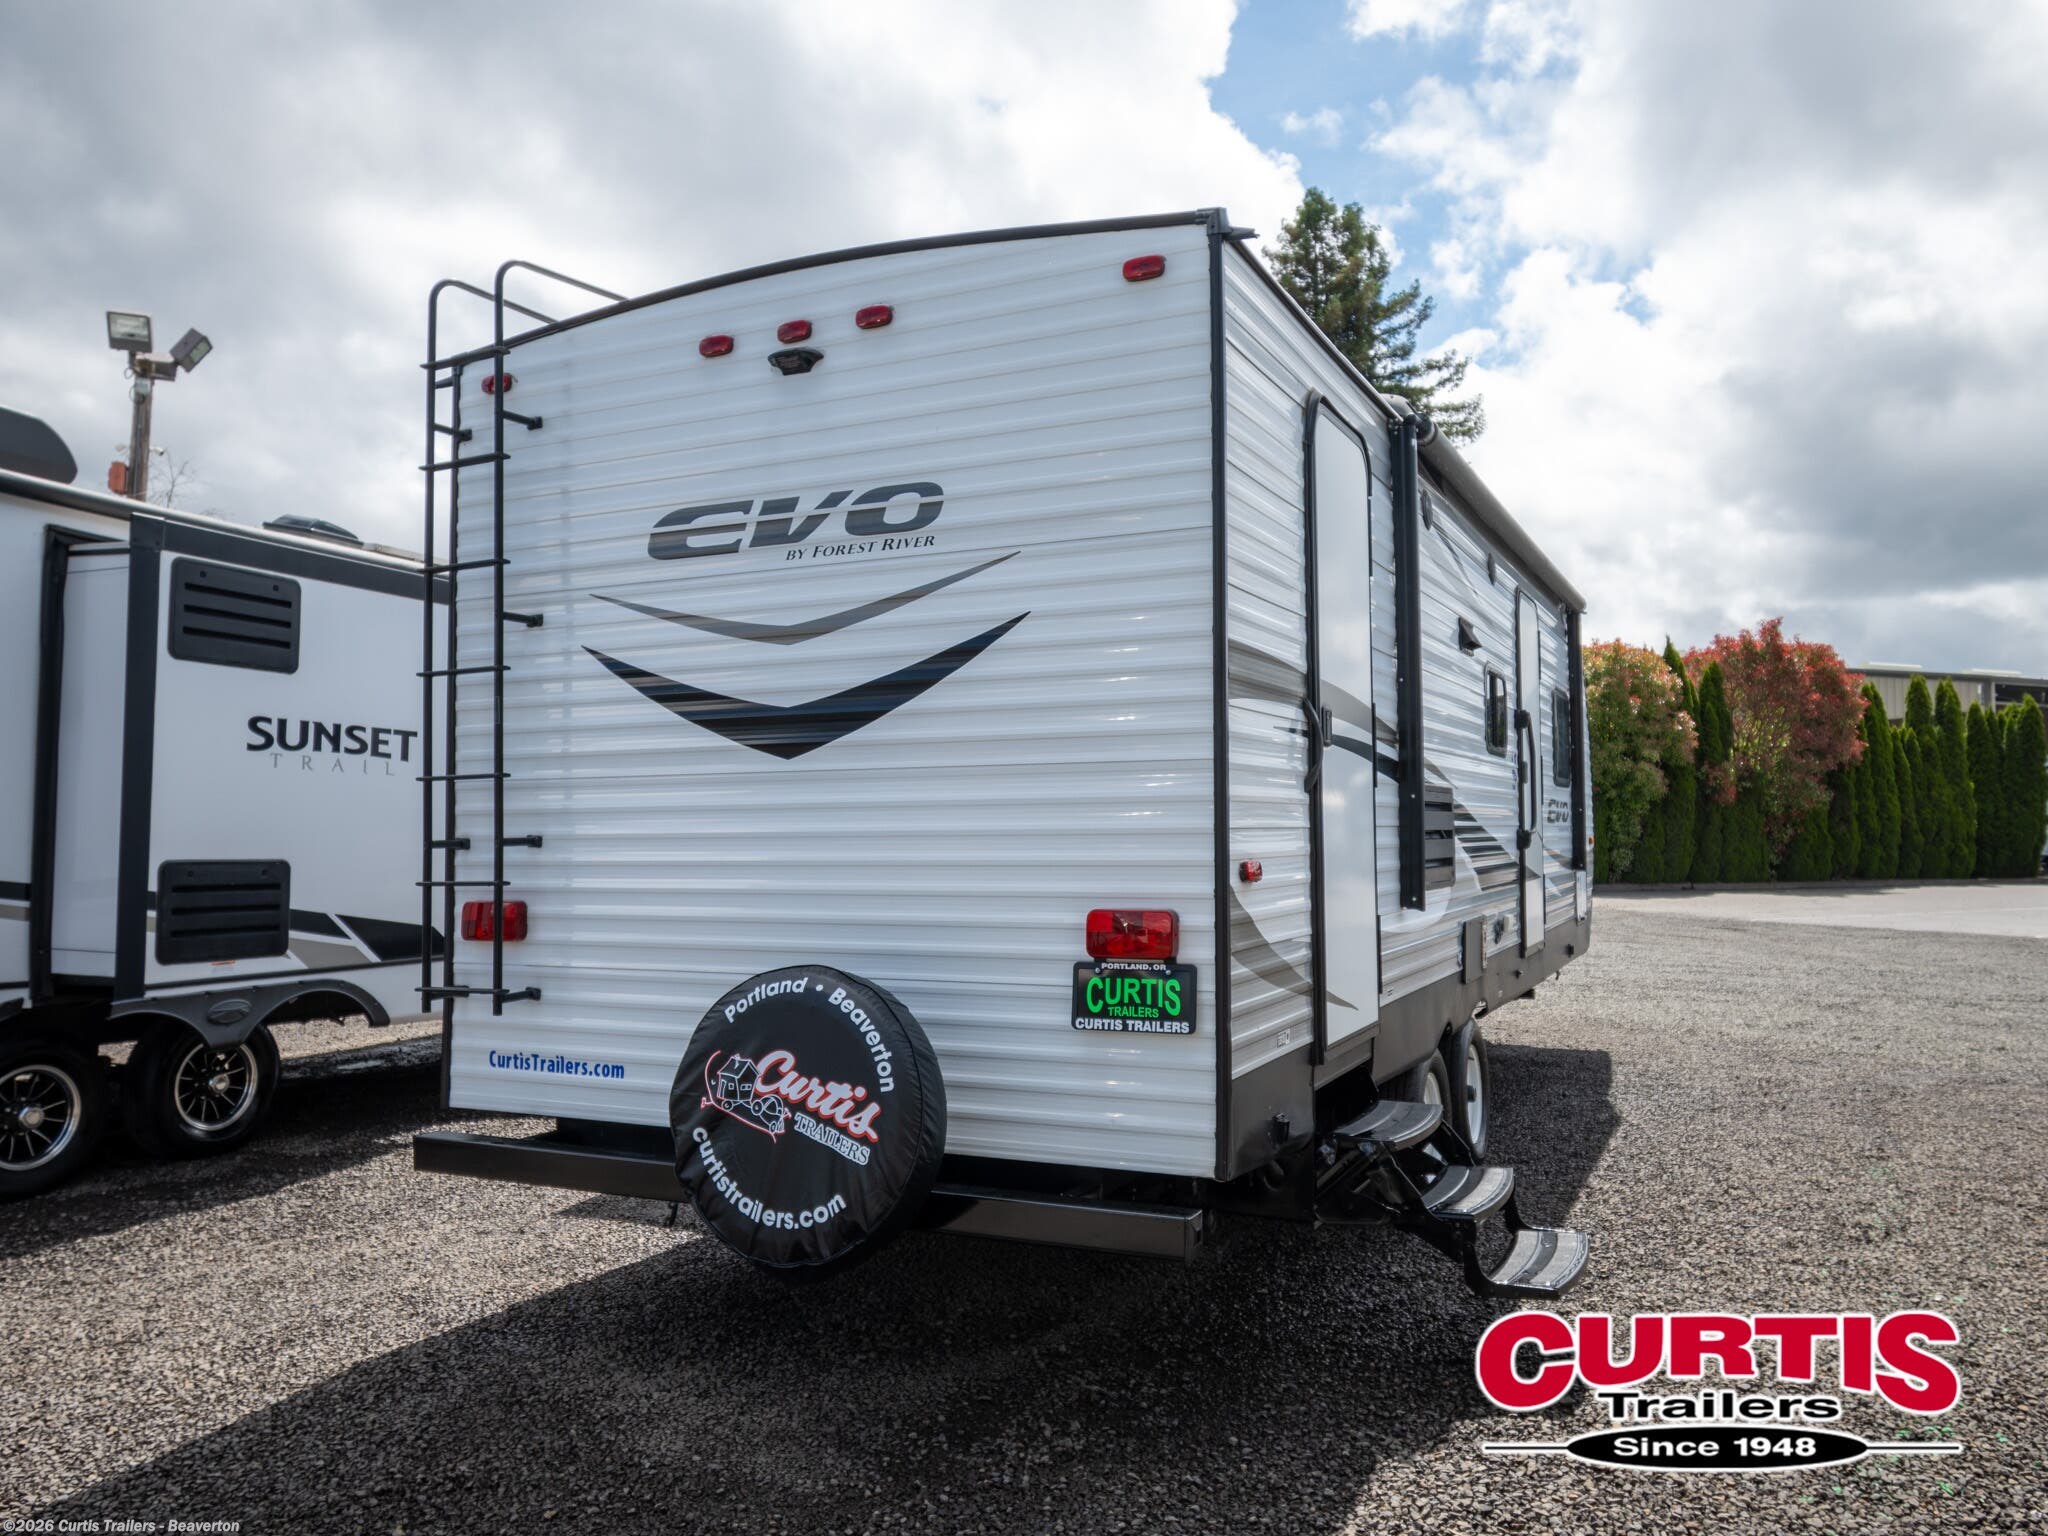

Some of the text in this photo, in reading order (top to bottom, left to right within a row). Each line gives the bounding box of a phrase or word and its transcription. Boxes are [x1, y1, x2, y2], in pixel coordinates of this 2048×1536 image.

[647, 481, 944, 561] EVO
[786, 535, 935, 561] BY FOREST RIVER
[246, 716, 418, 762] SUNSET
[270, 753, 395, 776] TRAIL
[1153, 963, 1167, 971] OR
[1086, 976, 1181, 1016] CURTIS
[1107, 1006, 1160, 1018] TRAILERS
[724, 977, 895, 1093] Portland Beaverton
[1075, 1017, 1190, 1034] CURTIS TRAILERS
[489, 1050, 625, 1079] CurtisTrailers.com
[755, 1050, 881, 1142] Curtis
[794, 1112, 871, 1166] TRAILERS
[692, 1127, 847, 1230] curtistrailers.com
